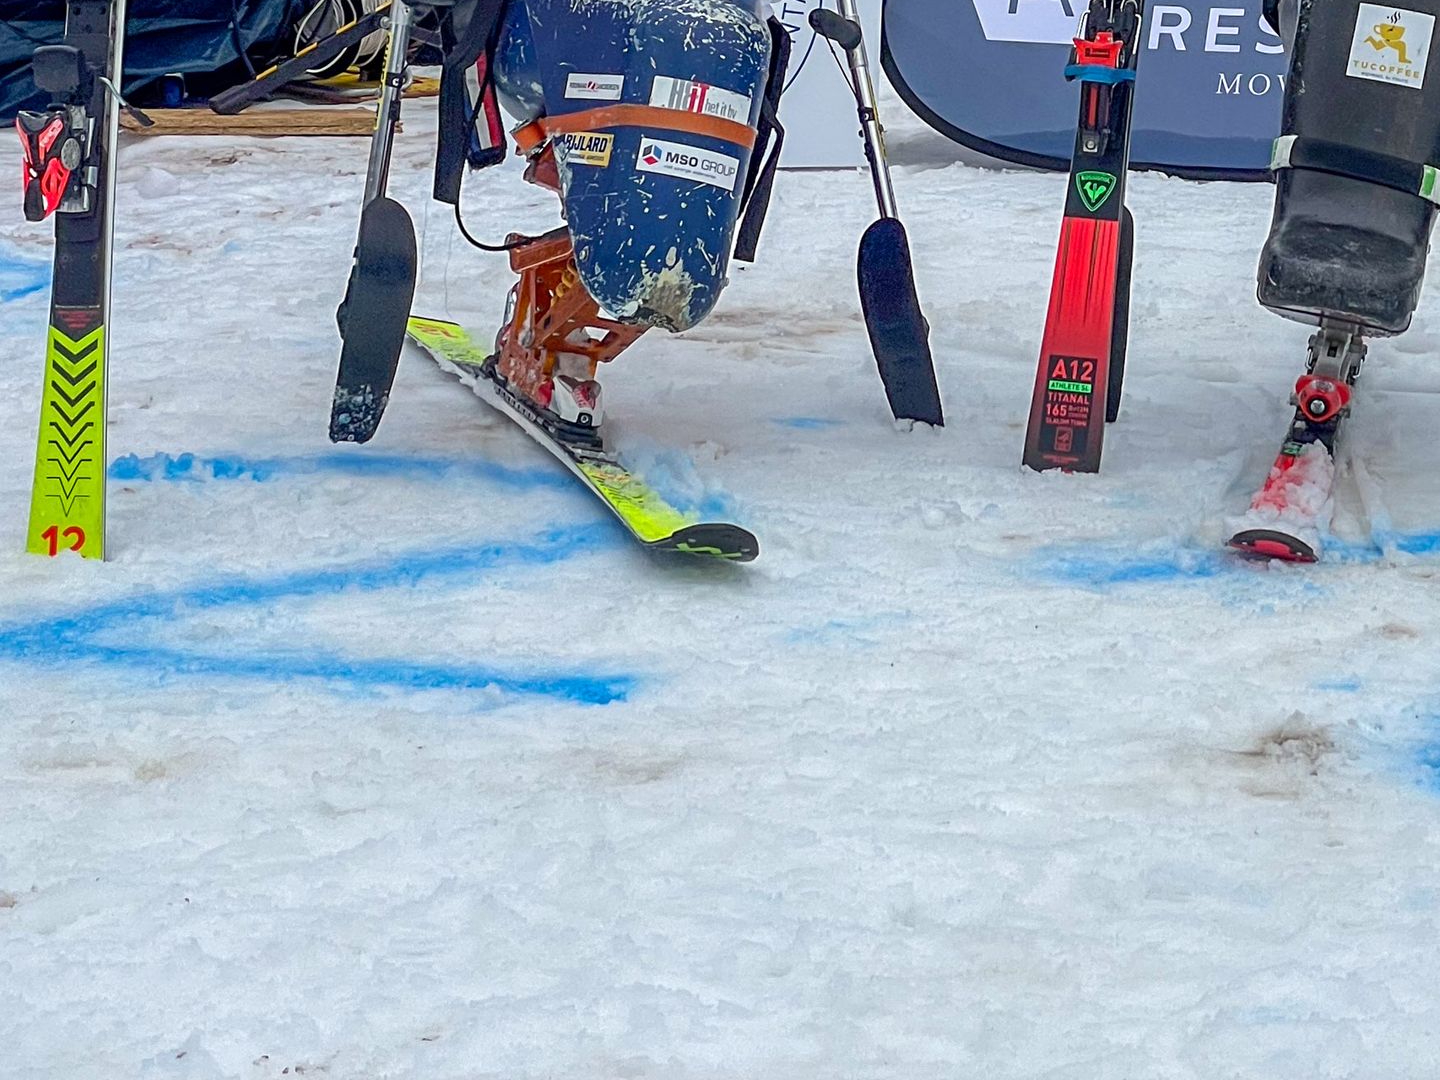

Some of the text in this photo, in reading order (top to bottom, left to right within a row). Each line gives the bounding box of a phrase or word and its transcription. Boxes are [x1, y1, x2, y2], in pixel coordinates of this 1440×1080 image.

[1353, 60, 1420, 78] TUCOFFEE
[665, 150, 698, 169] MSO
[701, 159, 736, 176] GROUP
[1052, 358, 1094, 381] A12
[1050, 382, 1079, 391] ATHLETE
[1048, 391, 1090, 405] TITANAL
[1046, 403, 1067, 417] 165
